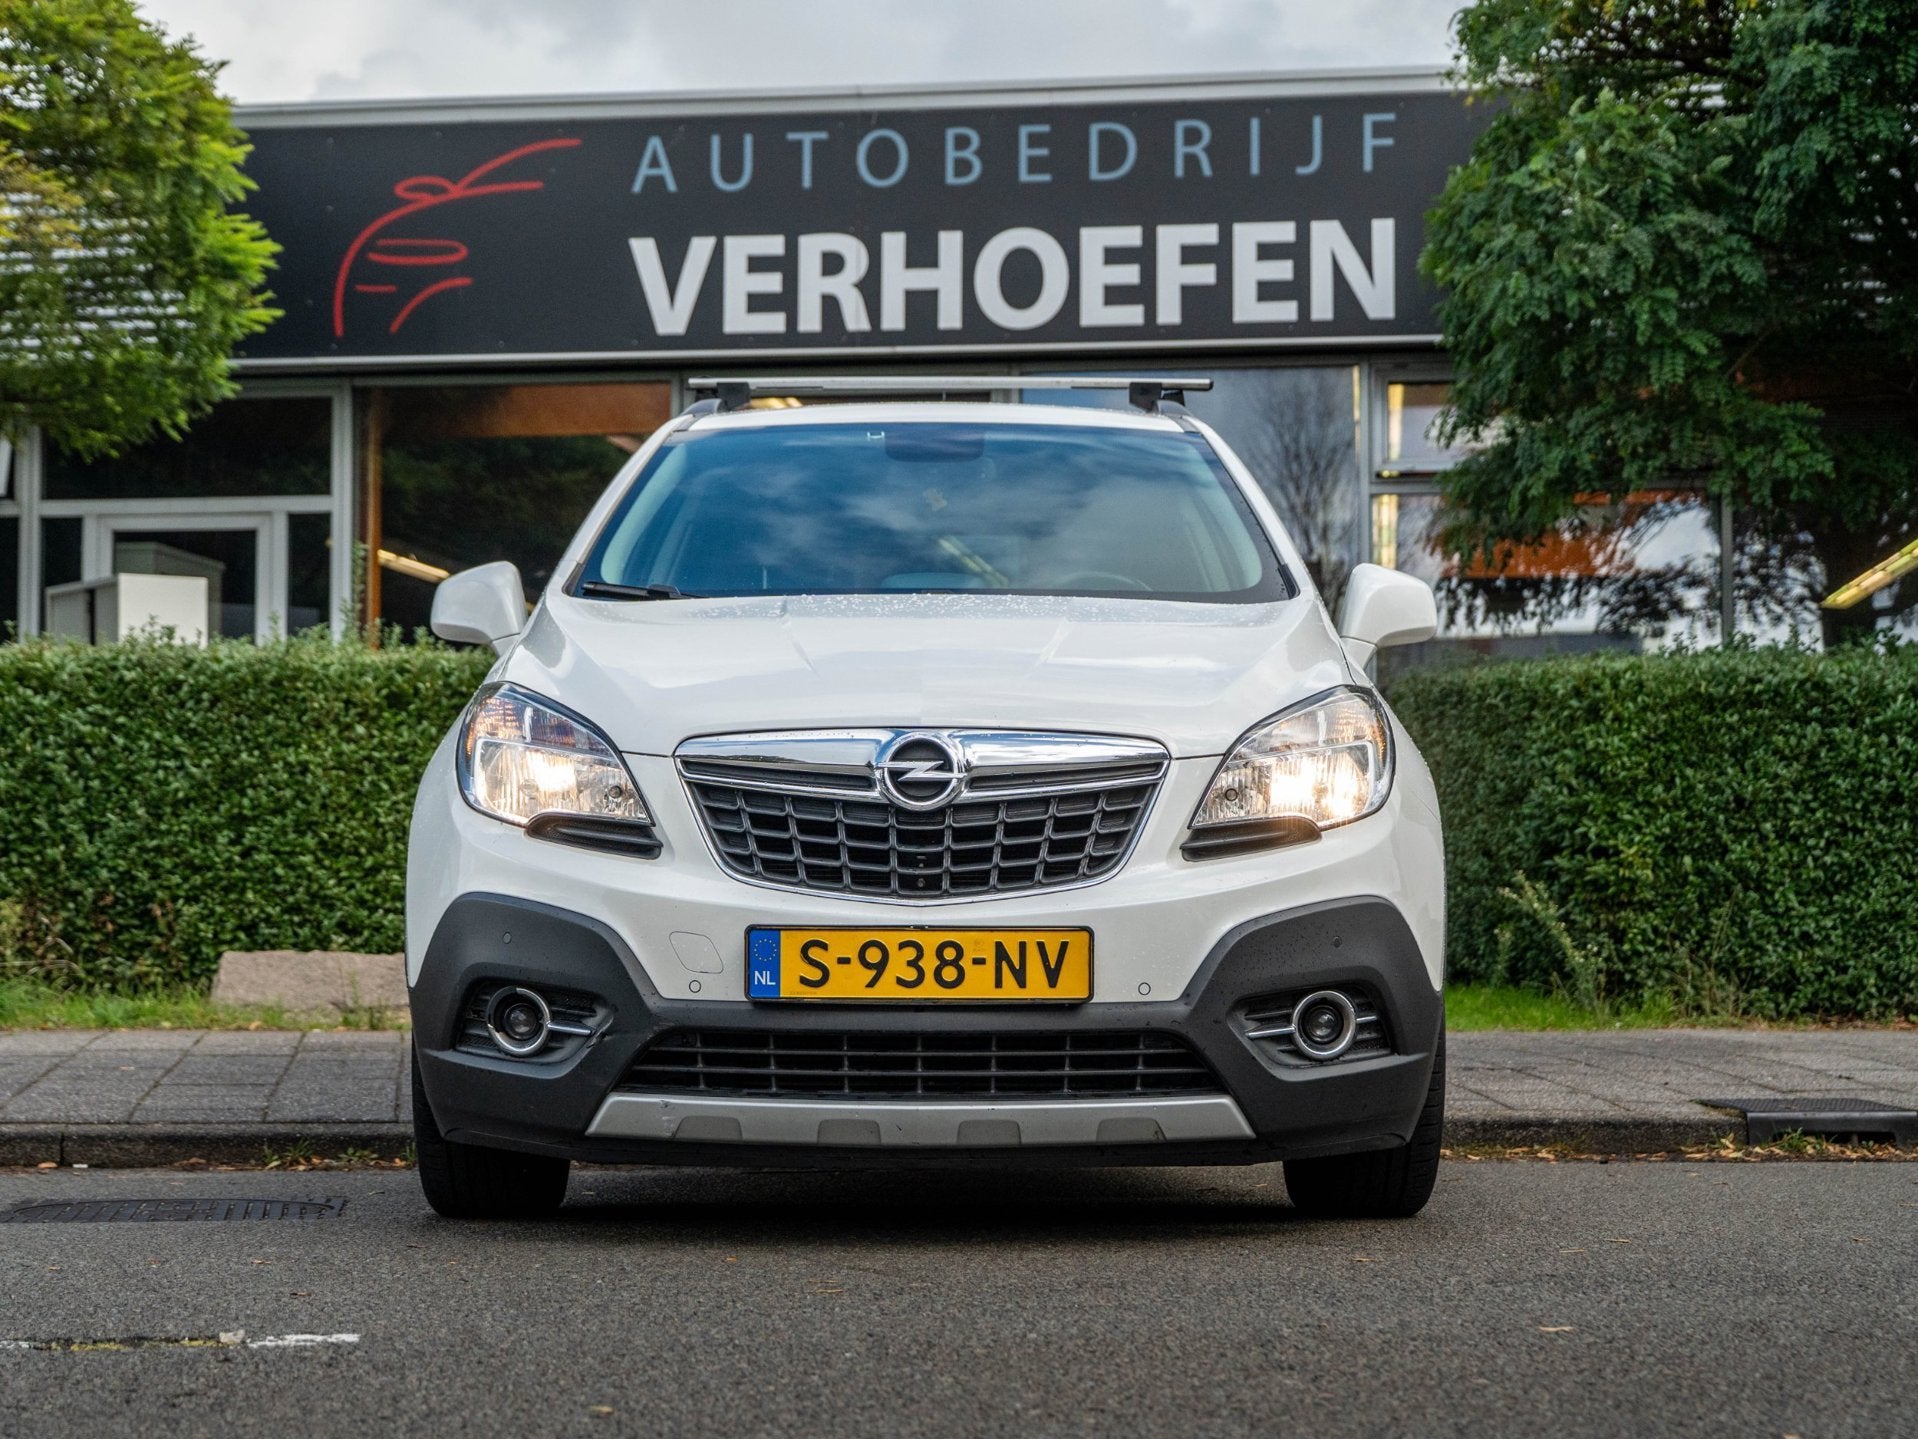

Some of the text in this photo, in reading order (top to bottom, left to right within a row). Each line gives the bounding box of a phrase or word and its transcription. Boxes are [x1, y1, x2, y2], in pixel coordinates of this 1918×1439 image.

[631, 112, 1397, 194] AUTOBEDRIJF
[628, 217, 1397, 337] VERHOEFEN
[753, 970, 776, 986] NL
[799, 939, 1070, 990] S-938-NV
